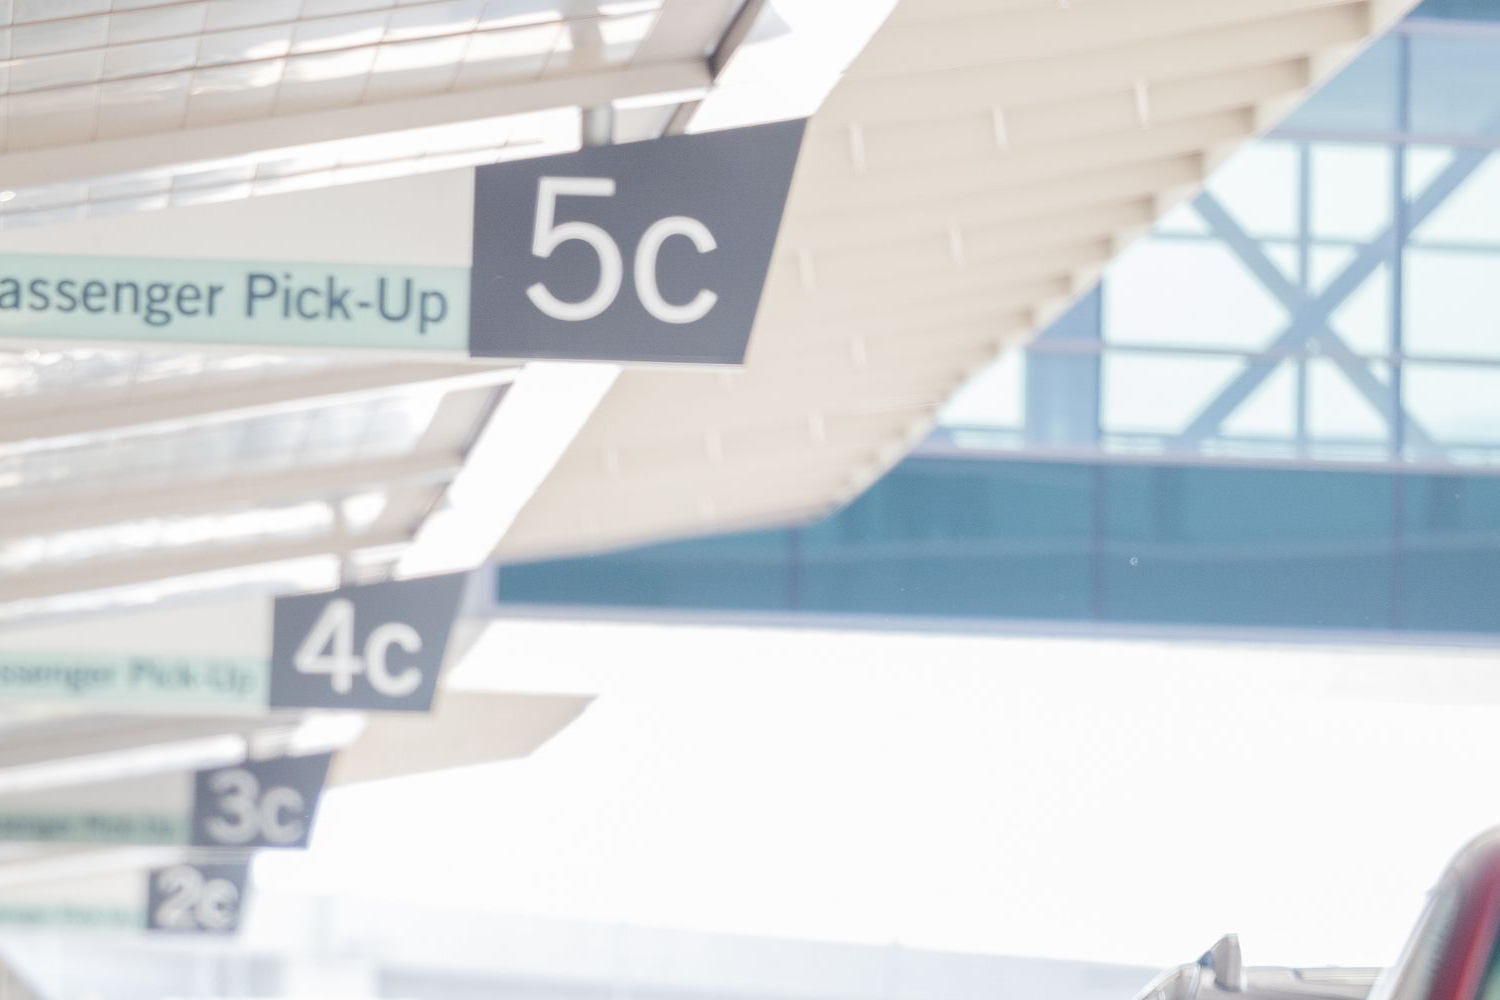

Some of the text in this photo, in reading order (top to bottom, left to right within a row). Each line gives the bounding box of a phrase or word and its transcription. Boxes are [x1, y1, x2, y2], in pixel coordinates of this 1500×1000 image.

[524, 176, 720, 325] 5c
[244, 270, 450, 334] Pick-Up
[294, 598, 423, 698] 4c
[205, 768, 304, 844] 3c
[153, 865, 240, 928] 2c
